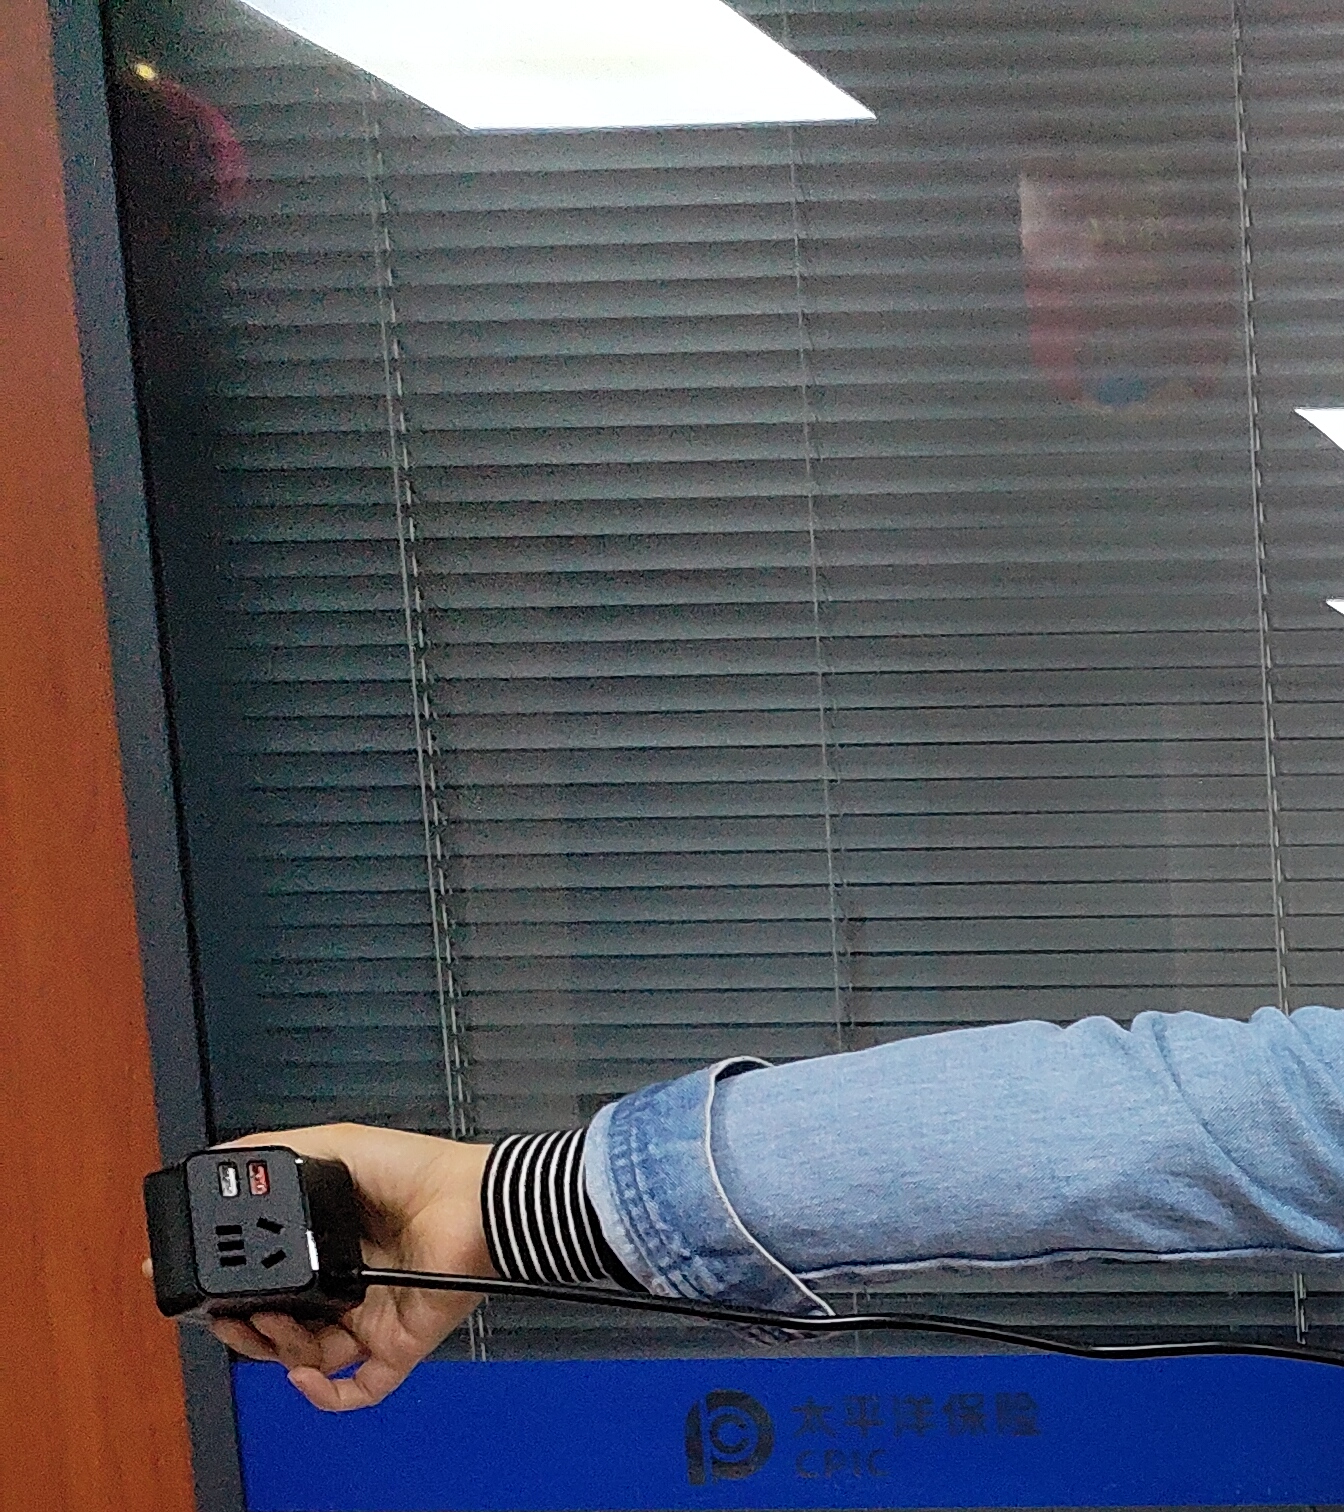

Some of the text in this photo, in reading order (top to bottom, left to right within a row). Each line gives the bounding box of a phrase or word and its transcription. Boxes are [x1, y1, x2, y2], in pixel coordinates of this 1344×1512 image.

[790, 1392, 1042, 1439] 太平洋保险
[794, 1449, 889, 1479] CPIC
